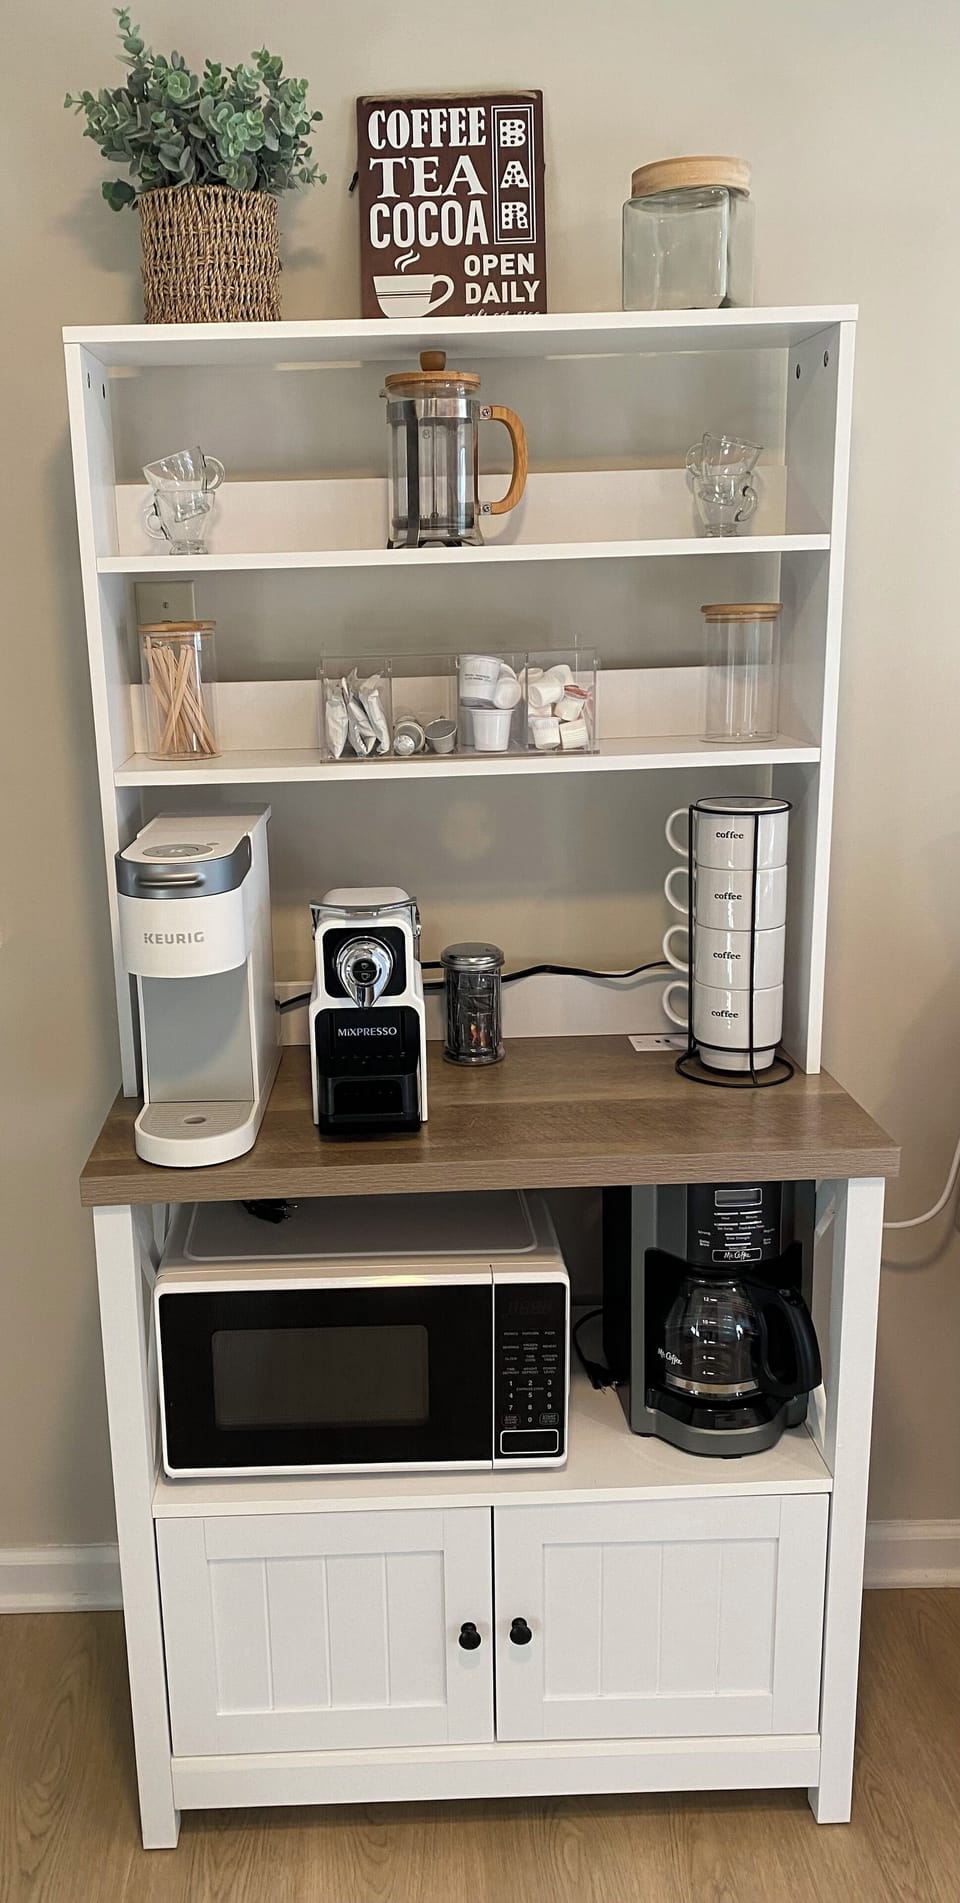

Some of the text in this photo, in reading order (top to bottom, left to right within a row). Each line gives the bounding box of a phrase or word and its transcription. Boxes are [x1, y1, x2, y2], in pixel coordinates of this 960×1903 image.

[367, 106, 487, 150] COFFEE
[368, 154, 488, 199] TEA
[499, 119, 529, 230] BAR
[369, 200, 489, 249] COCOA
[464, 252, 535, 277] OPEN
[465, 280, 541, 305] DAILY
[715, 830, 744, 840] coffee
[714, 892, 743, 900] coffee
[143, 931, 205, 944] KEURIG
[712, 951, 742, 960] coffee
[711, 1010, 739, 1018] coffee
